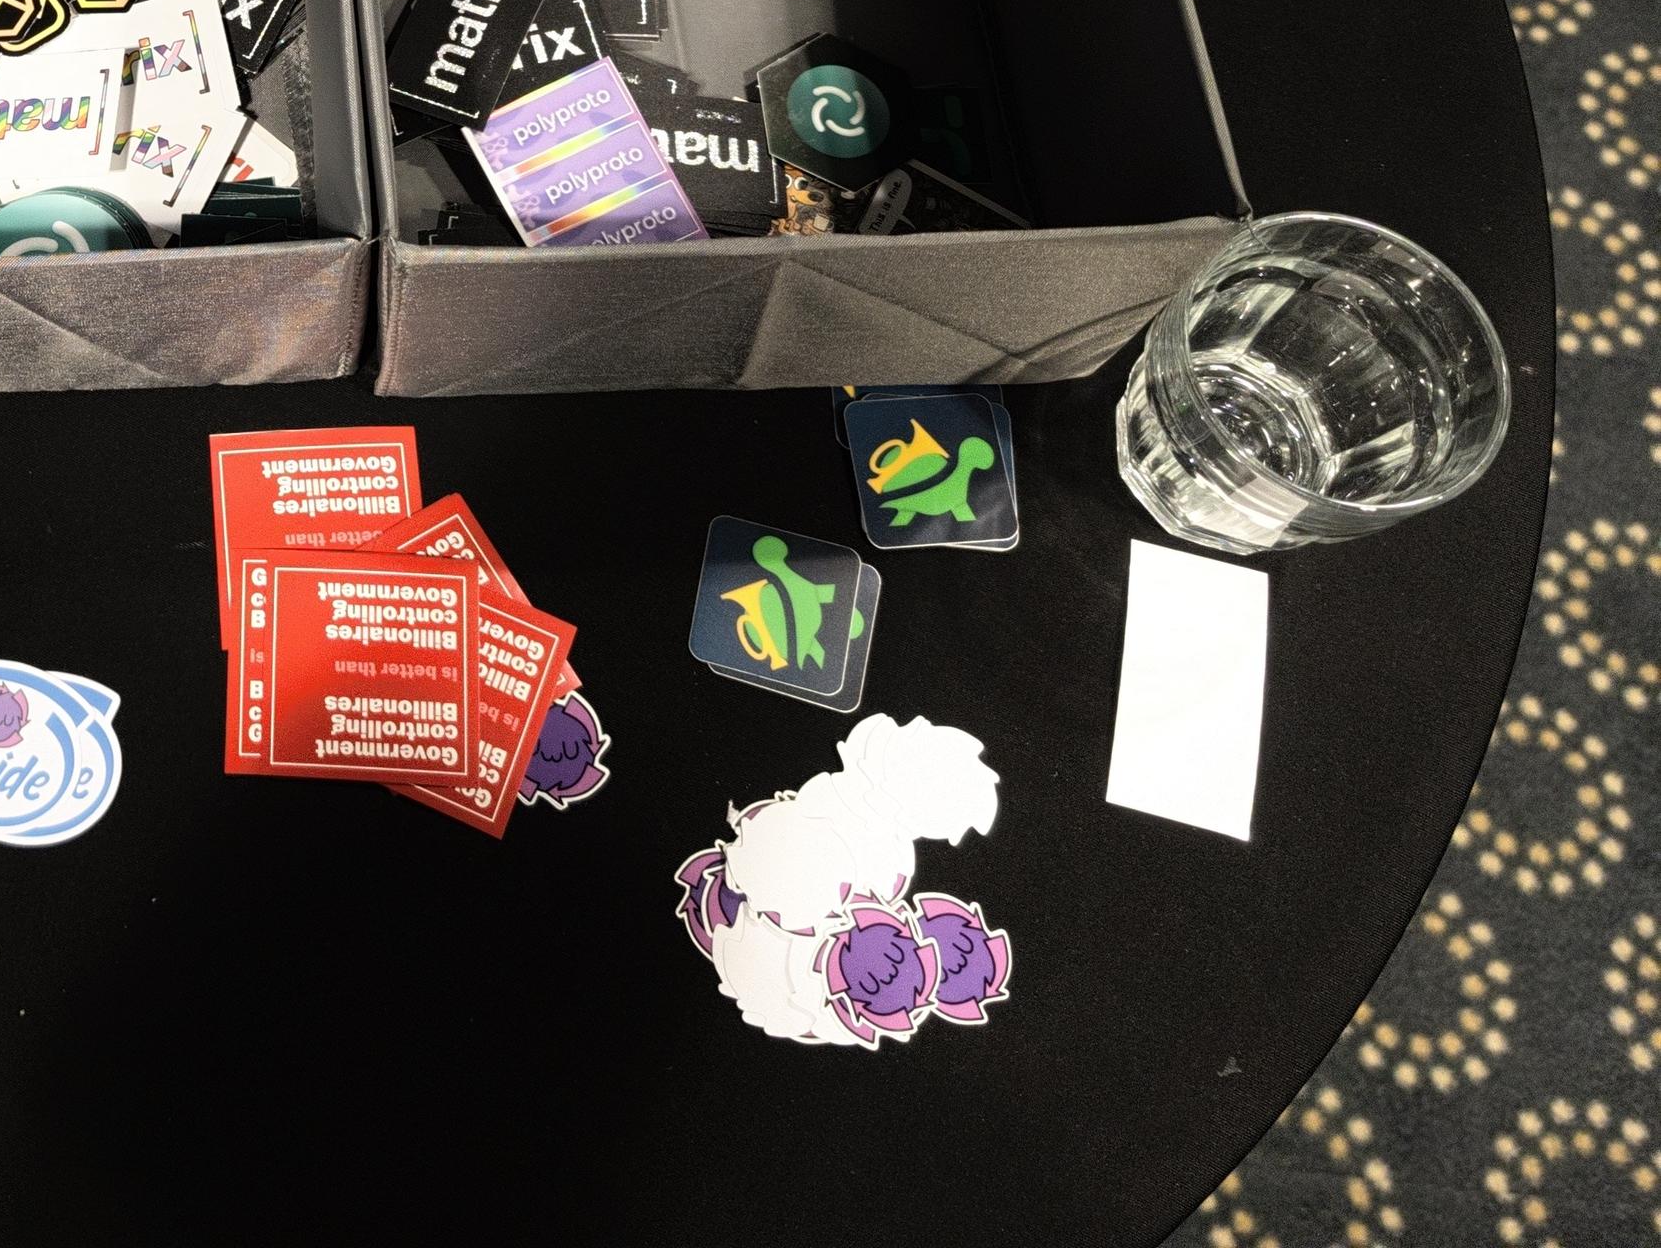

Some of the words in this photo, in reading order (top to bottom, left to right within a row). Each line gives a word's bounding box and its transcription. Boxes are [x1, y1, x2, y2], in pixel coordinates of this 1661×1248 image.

[512, 87, 612, 145] polyproto
[545, 146, 644, 205] polyproto
[261, 455, 397, 479] Government
[277, 475, 399, 496] controlling
[272, 495, 401, 518] Billionaires
[284, 533, 326, 547] than
[317, 581, 458, 607] Government
[331, 599, 458, 625] controlling
[324, 624, 458, 650] Billionaires
[334, 660, 377, 677] than
[381, 662, 437, 680] better
[441, 666, 458, 682] is
[323, 695, 458, 722] Billionaires
[330, 714, 458, 740] controlling
[314, 738, 459, 766] Government
